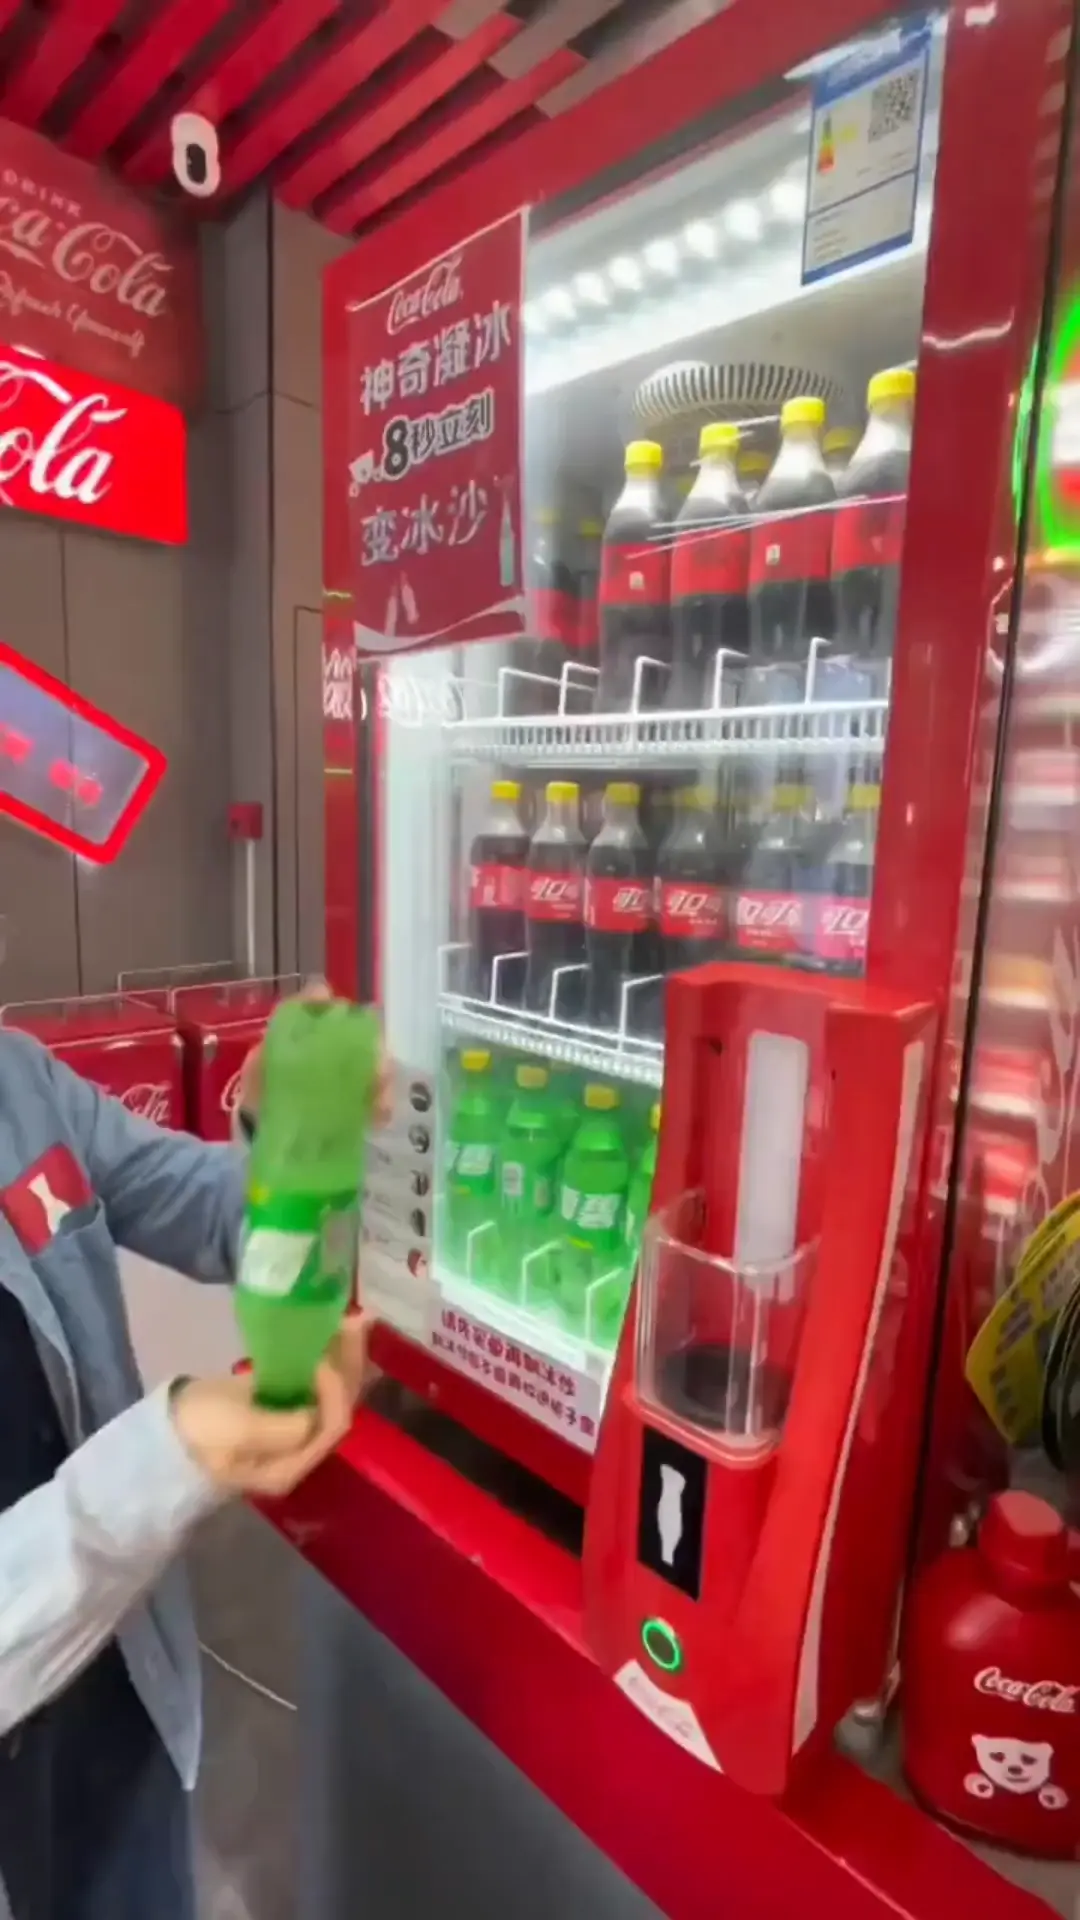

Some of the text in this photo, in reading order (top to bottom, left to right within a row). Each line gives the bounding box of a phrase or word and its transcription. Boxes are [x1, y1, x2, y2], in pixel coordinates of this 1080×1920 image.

[360, 300, 511, 416] 神奇凝冰
[383, 388, 494, 479] 8秒立刻
[361, 480, 488, 567] 变冰沙
[974, 1666, 1080, 1713] Coca-Cola
